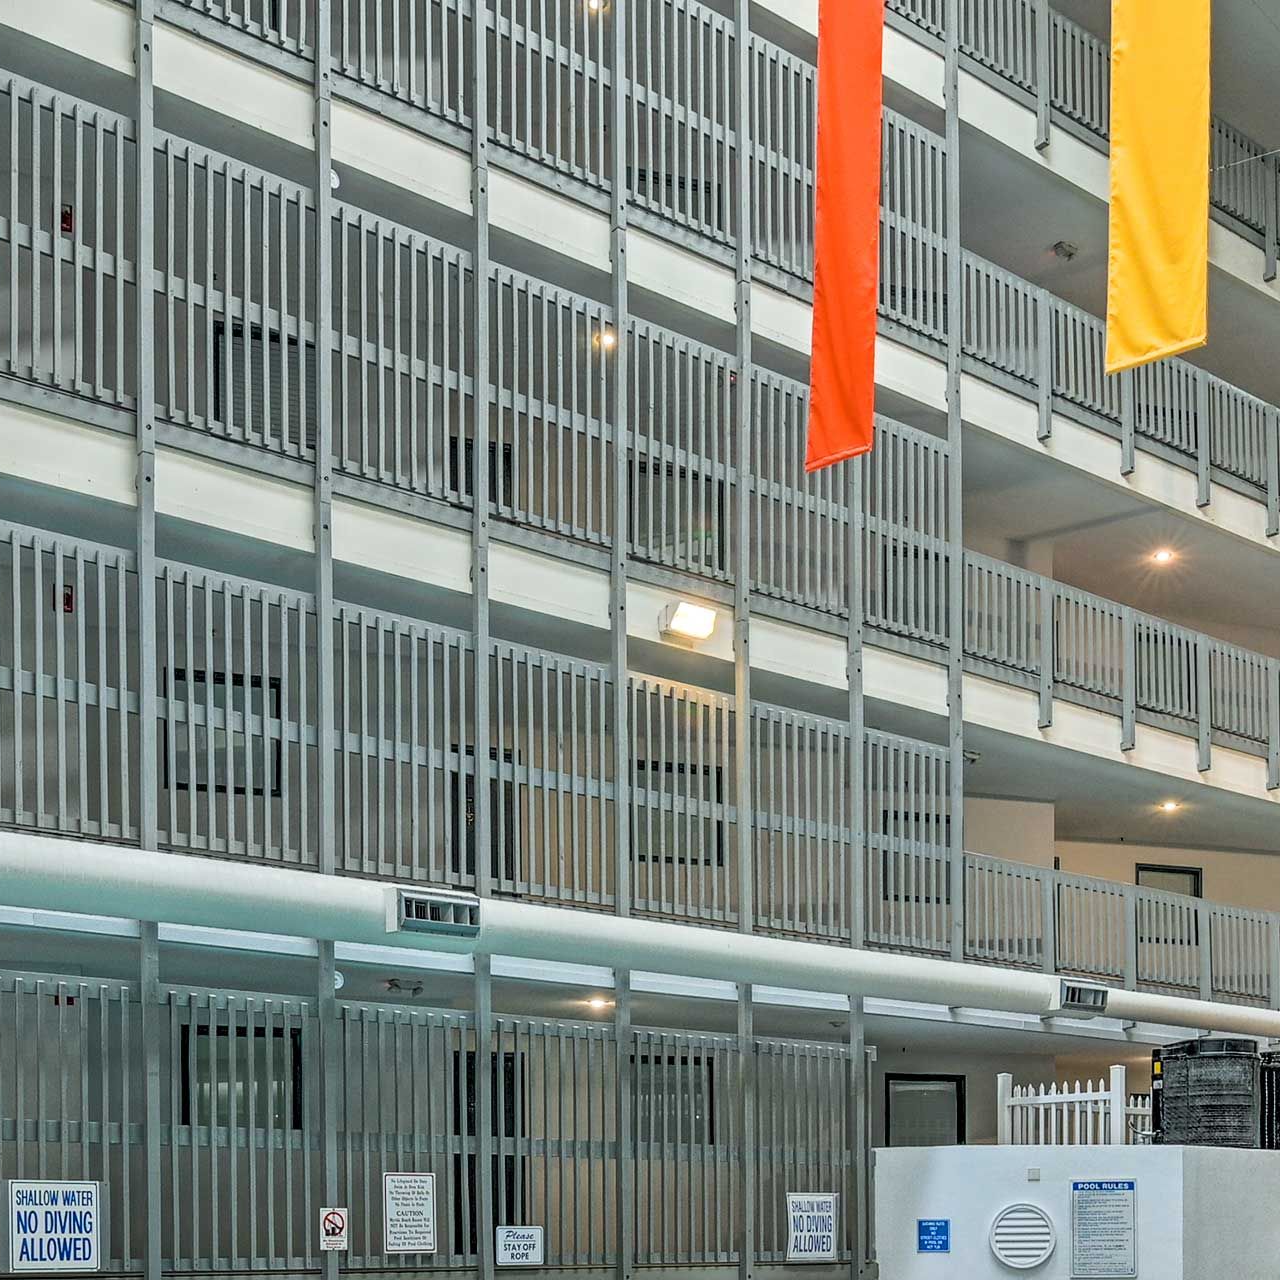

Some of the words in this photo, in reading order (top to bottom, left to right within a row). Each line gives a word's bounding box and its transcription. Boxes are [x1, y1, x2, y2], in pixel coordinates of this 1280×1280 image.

[16, 1190, 59, 1206] SHALLOW
[62, 1191, 93, 1206] WATER
[791, 1200, 816, 1213] SHALLOW
[17, 1211, 38, 1234] NO
[45, 1211, 93, 1234] DIVING
[793, 1215, 804, 1232] NO
[806, 1215, 832, 1233] DIVING
[505, 1230, 534, 1240] Please
[19, 1238, 92, 1261] ALLOWED
[504, 1243, 521, 1251] STAY
[522, 1243, 536, 1251] OFF
[792, 1235, 832, 1252] ALLOWED
[510, 1252, 529, 1260] ROPE
